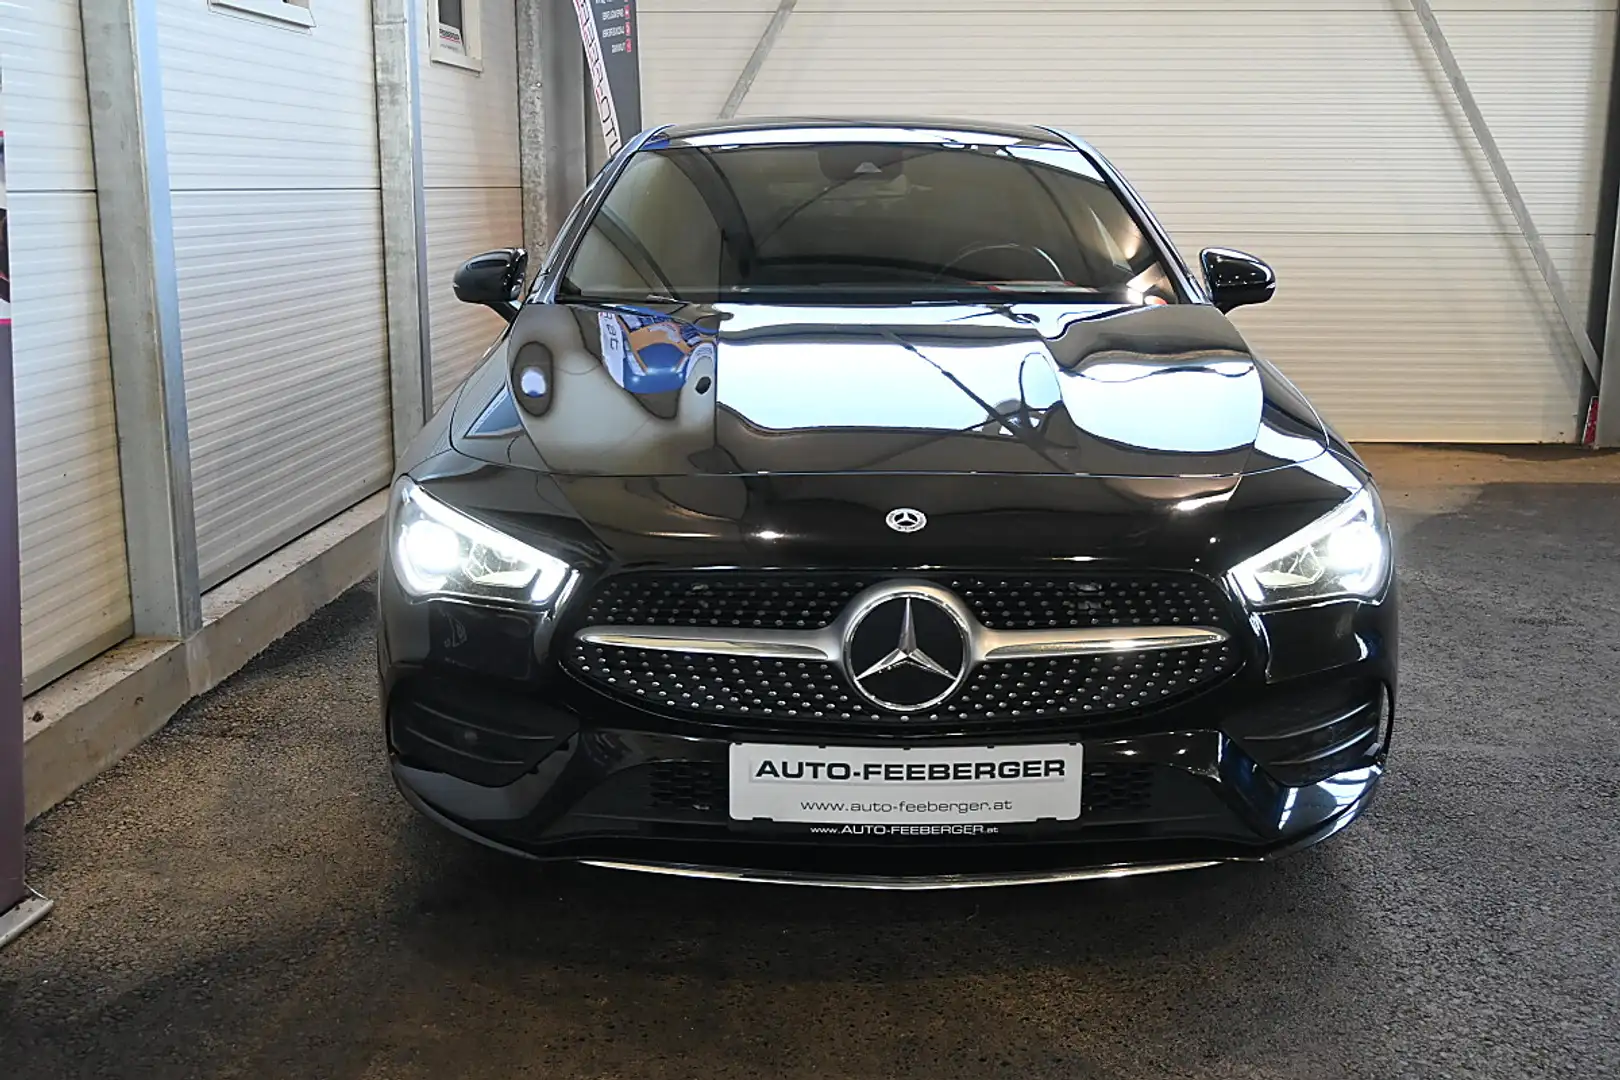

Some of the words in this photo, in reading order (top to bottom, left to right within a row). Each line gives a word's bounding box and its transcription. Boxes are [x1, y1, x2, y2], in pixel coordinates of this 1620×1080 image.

[755, 759, 1066, 781] AUTO-FEEBERGER
[800, 800, 1013, 814] www.auto-feeberger.at
[810, 824, 999, 836] www.AUTO-FEEBERGER.at
